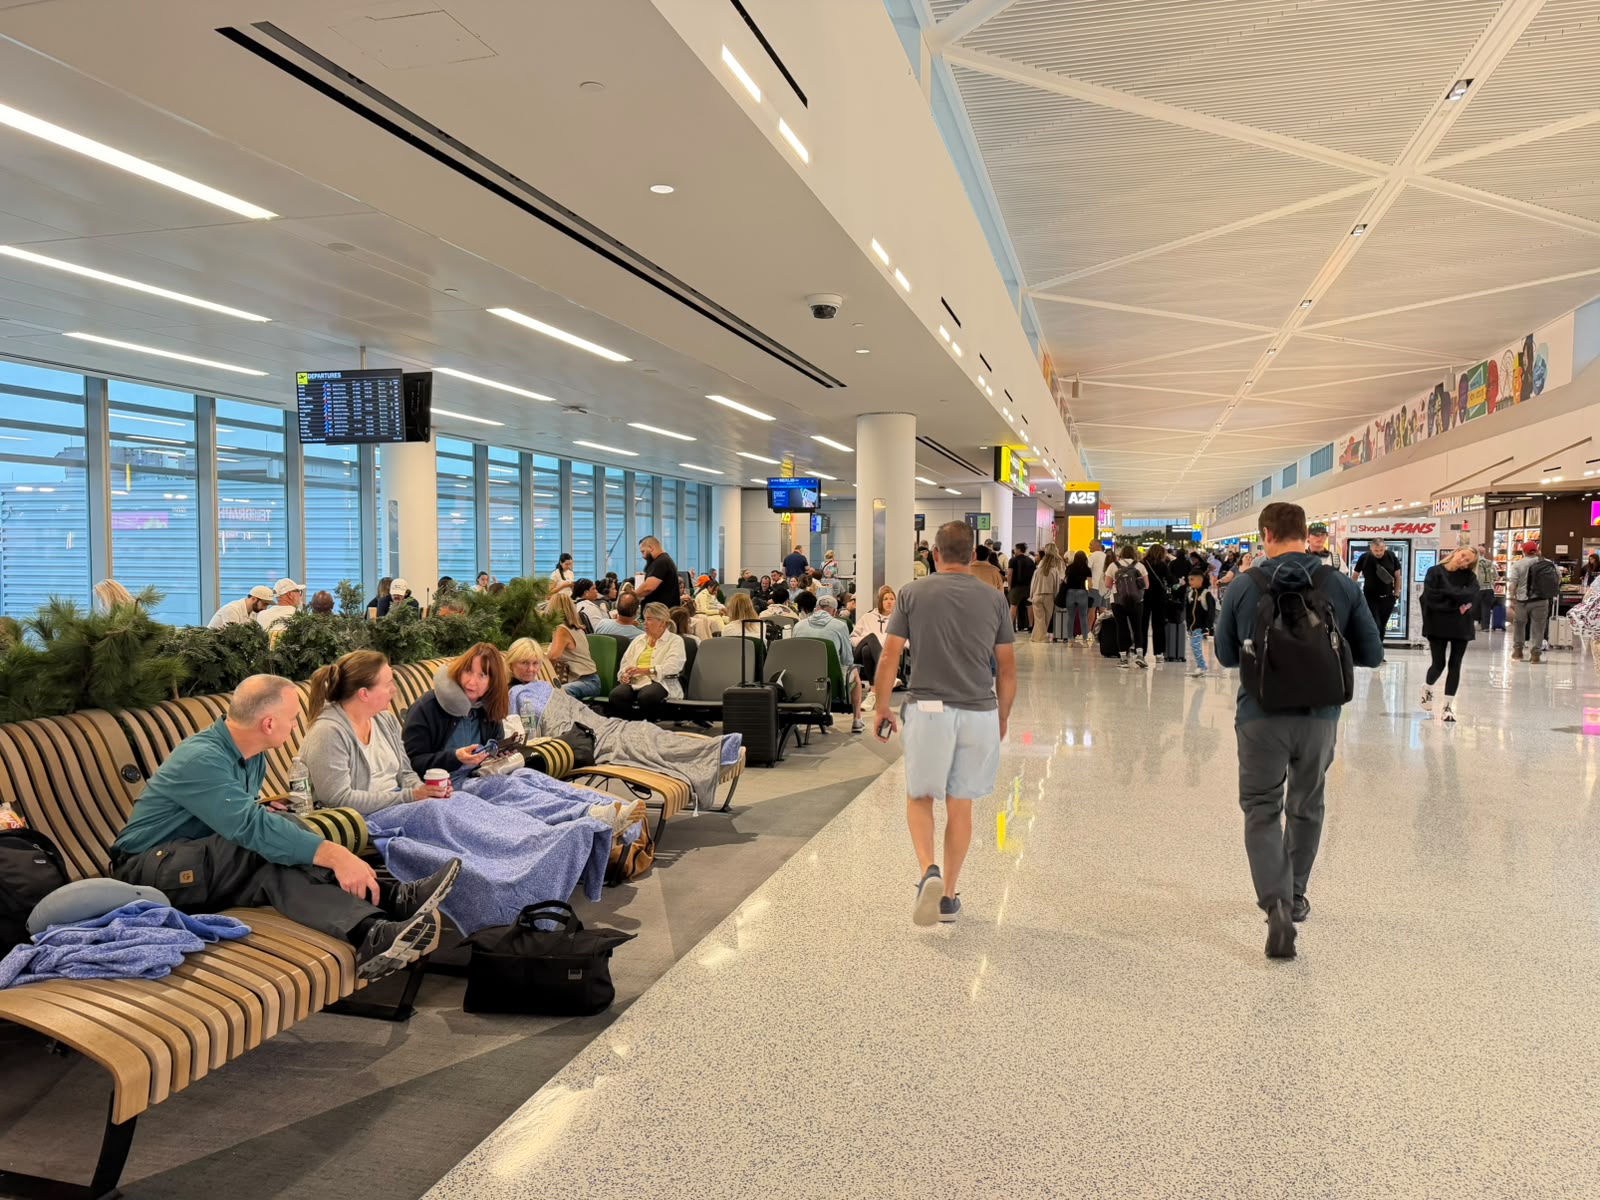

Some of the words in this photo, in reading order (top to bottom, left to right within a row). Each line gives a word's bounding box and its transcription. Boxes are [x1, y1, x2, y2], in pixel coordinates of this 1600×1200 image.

[1068, 491, 1096, 504] A25
[1358, 524, 1390, 533] ShopAll
[1391, 522, 1436, 535] FANS
